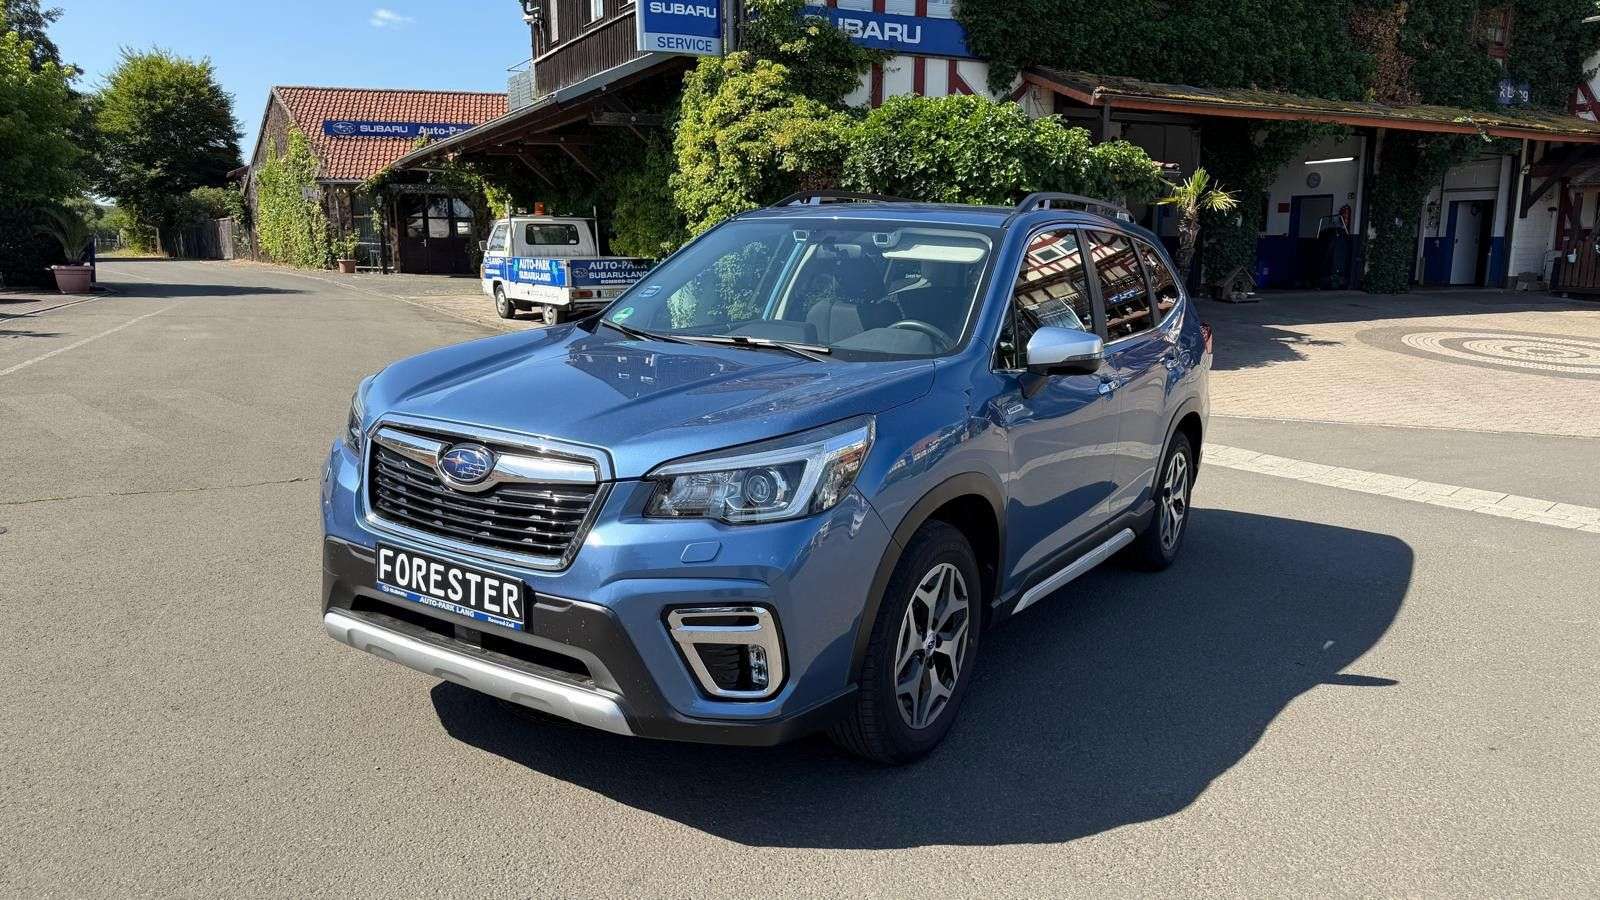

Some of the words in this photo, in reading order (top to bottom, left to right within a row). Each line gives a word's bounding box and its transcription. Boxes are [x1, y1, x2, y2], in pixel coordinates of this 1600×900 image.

[650, 2, 717, 18] SUBARU
[804, 14, 921, 44] BARU
[657, 36, 712, 52] SERVICE
[360, 125, 408, 133] SUBARU
[519, 258, 550, 270] AUTO-PARK
[379, 548, 520, 618] FORESTER
[419, 596, 455, 612] AUTO-PARK
[456, 606, 475, 618] LANG
